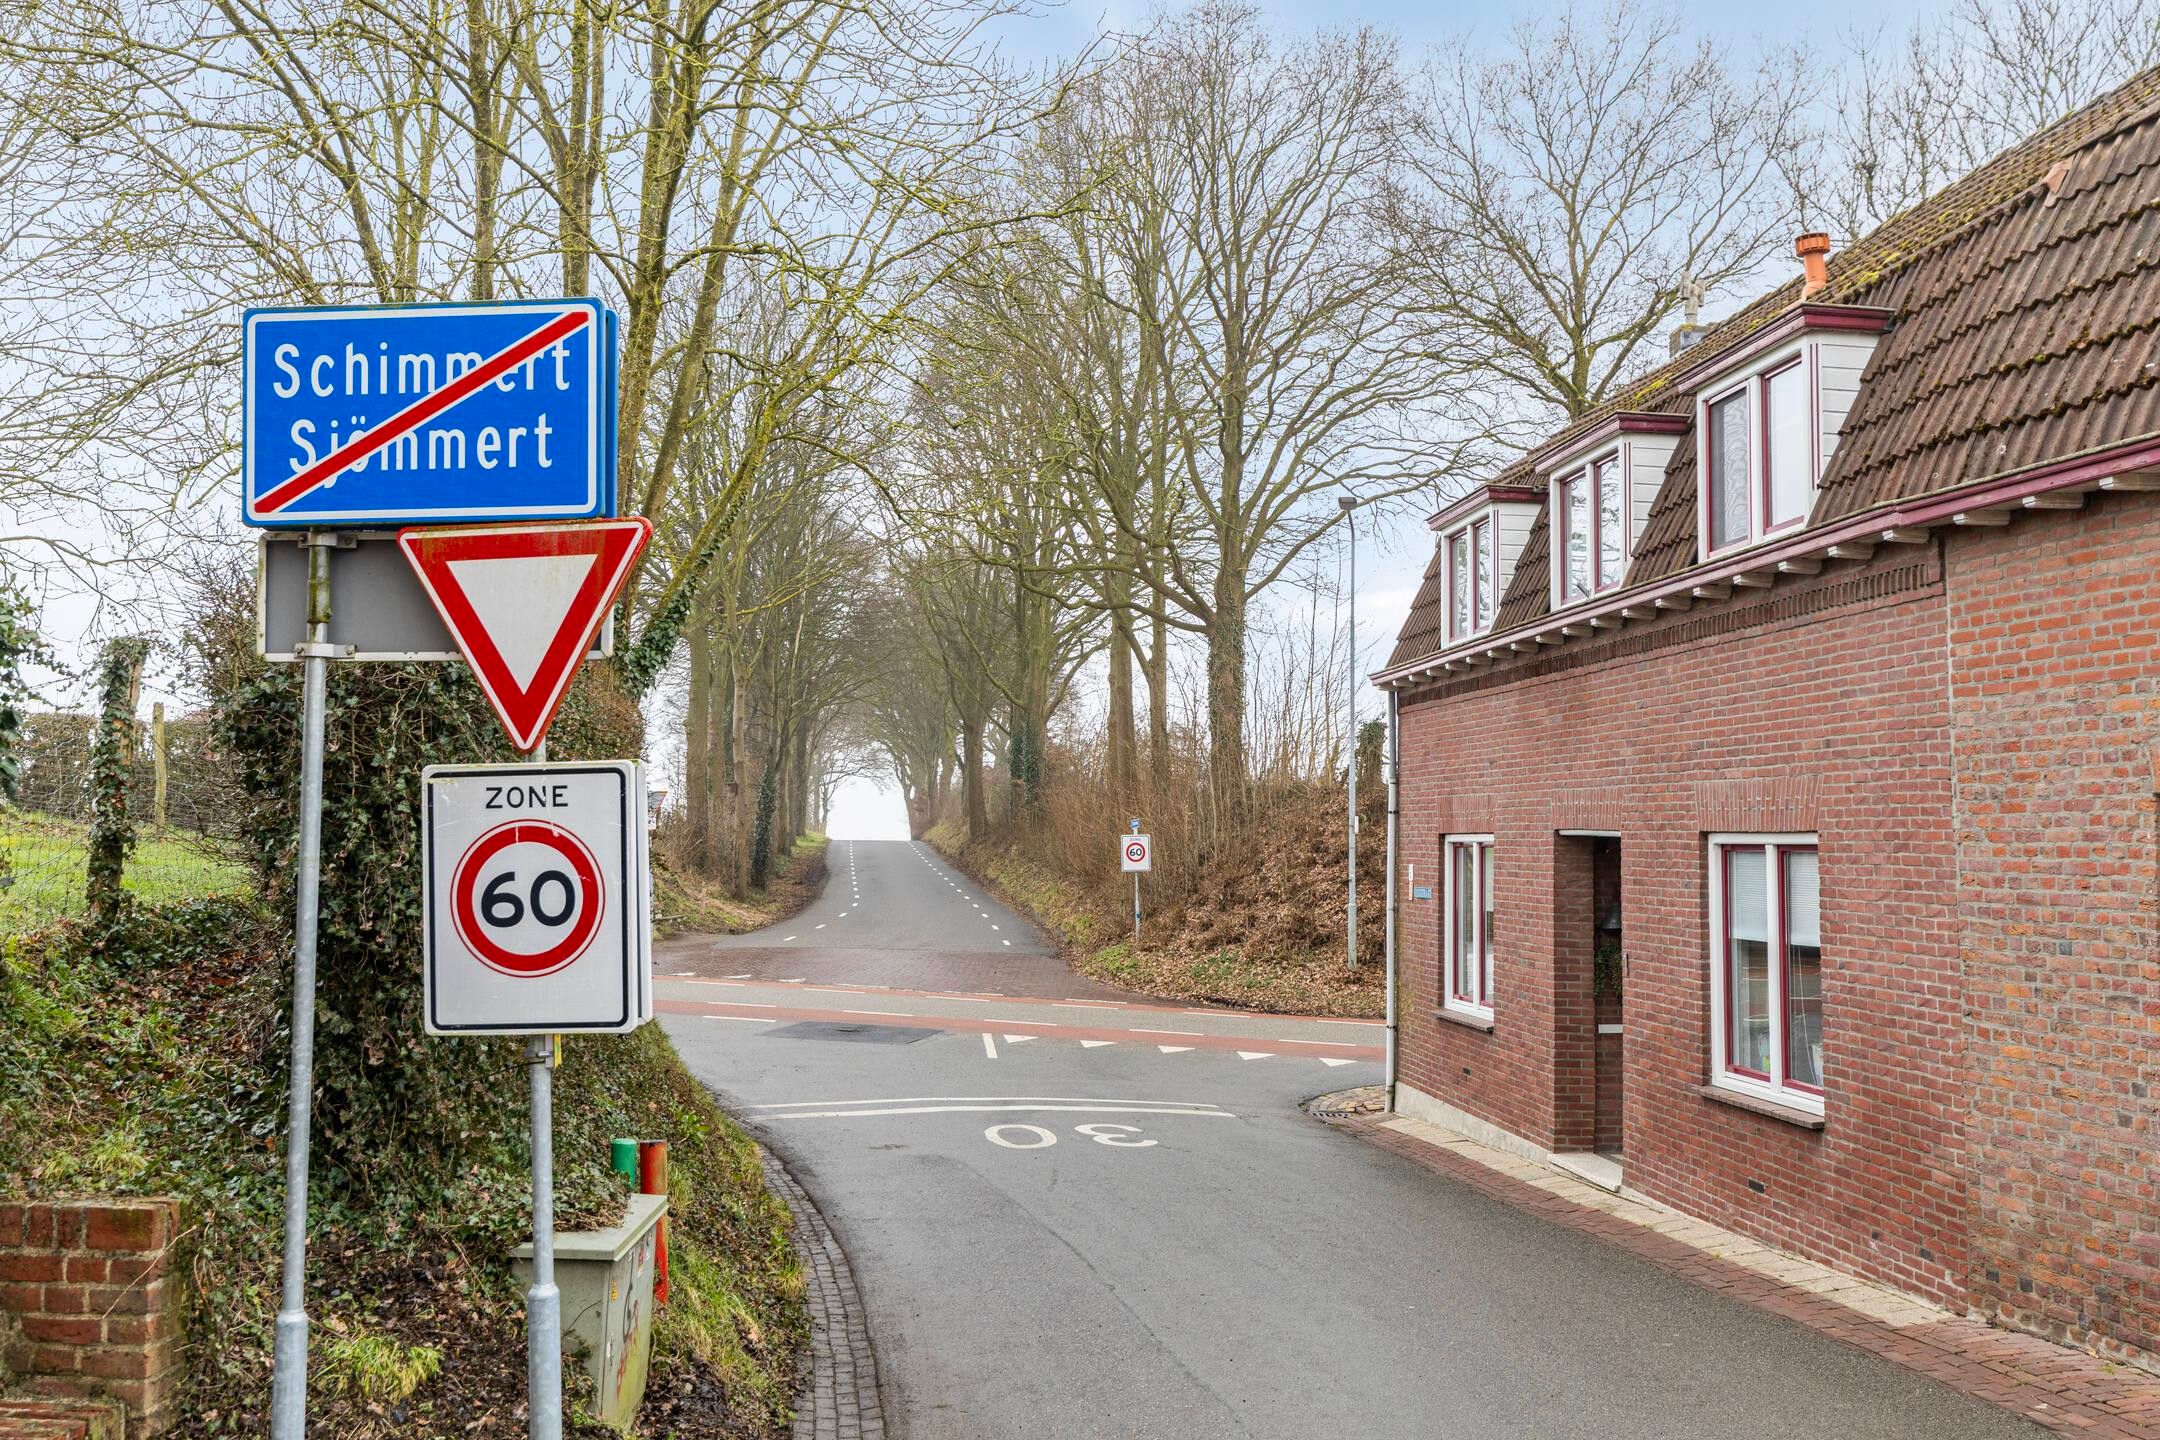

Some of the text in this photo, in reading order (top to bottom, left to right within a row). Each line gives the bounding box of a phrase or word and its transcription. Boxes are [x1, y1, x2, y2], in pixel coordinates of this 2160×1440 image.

[272, 340, 571, 399] Schimmert
[485, 785, 569, 809] ZONE
[1129, 848, 1142, 857] 60
[480, 869, 576, 928] 60
